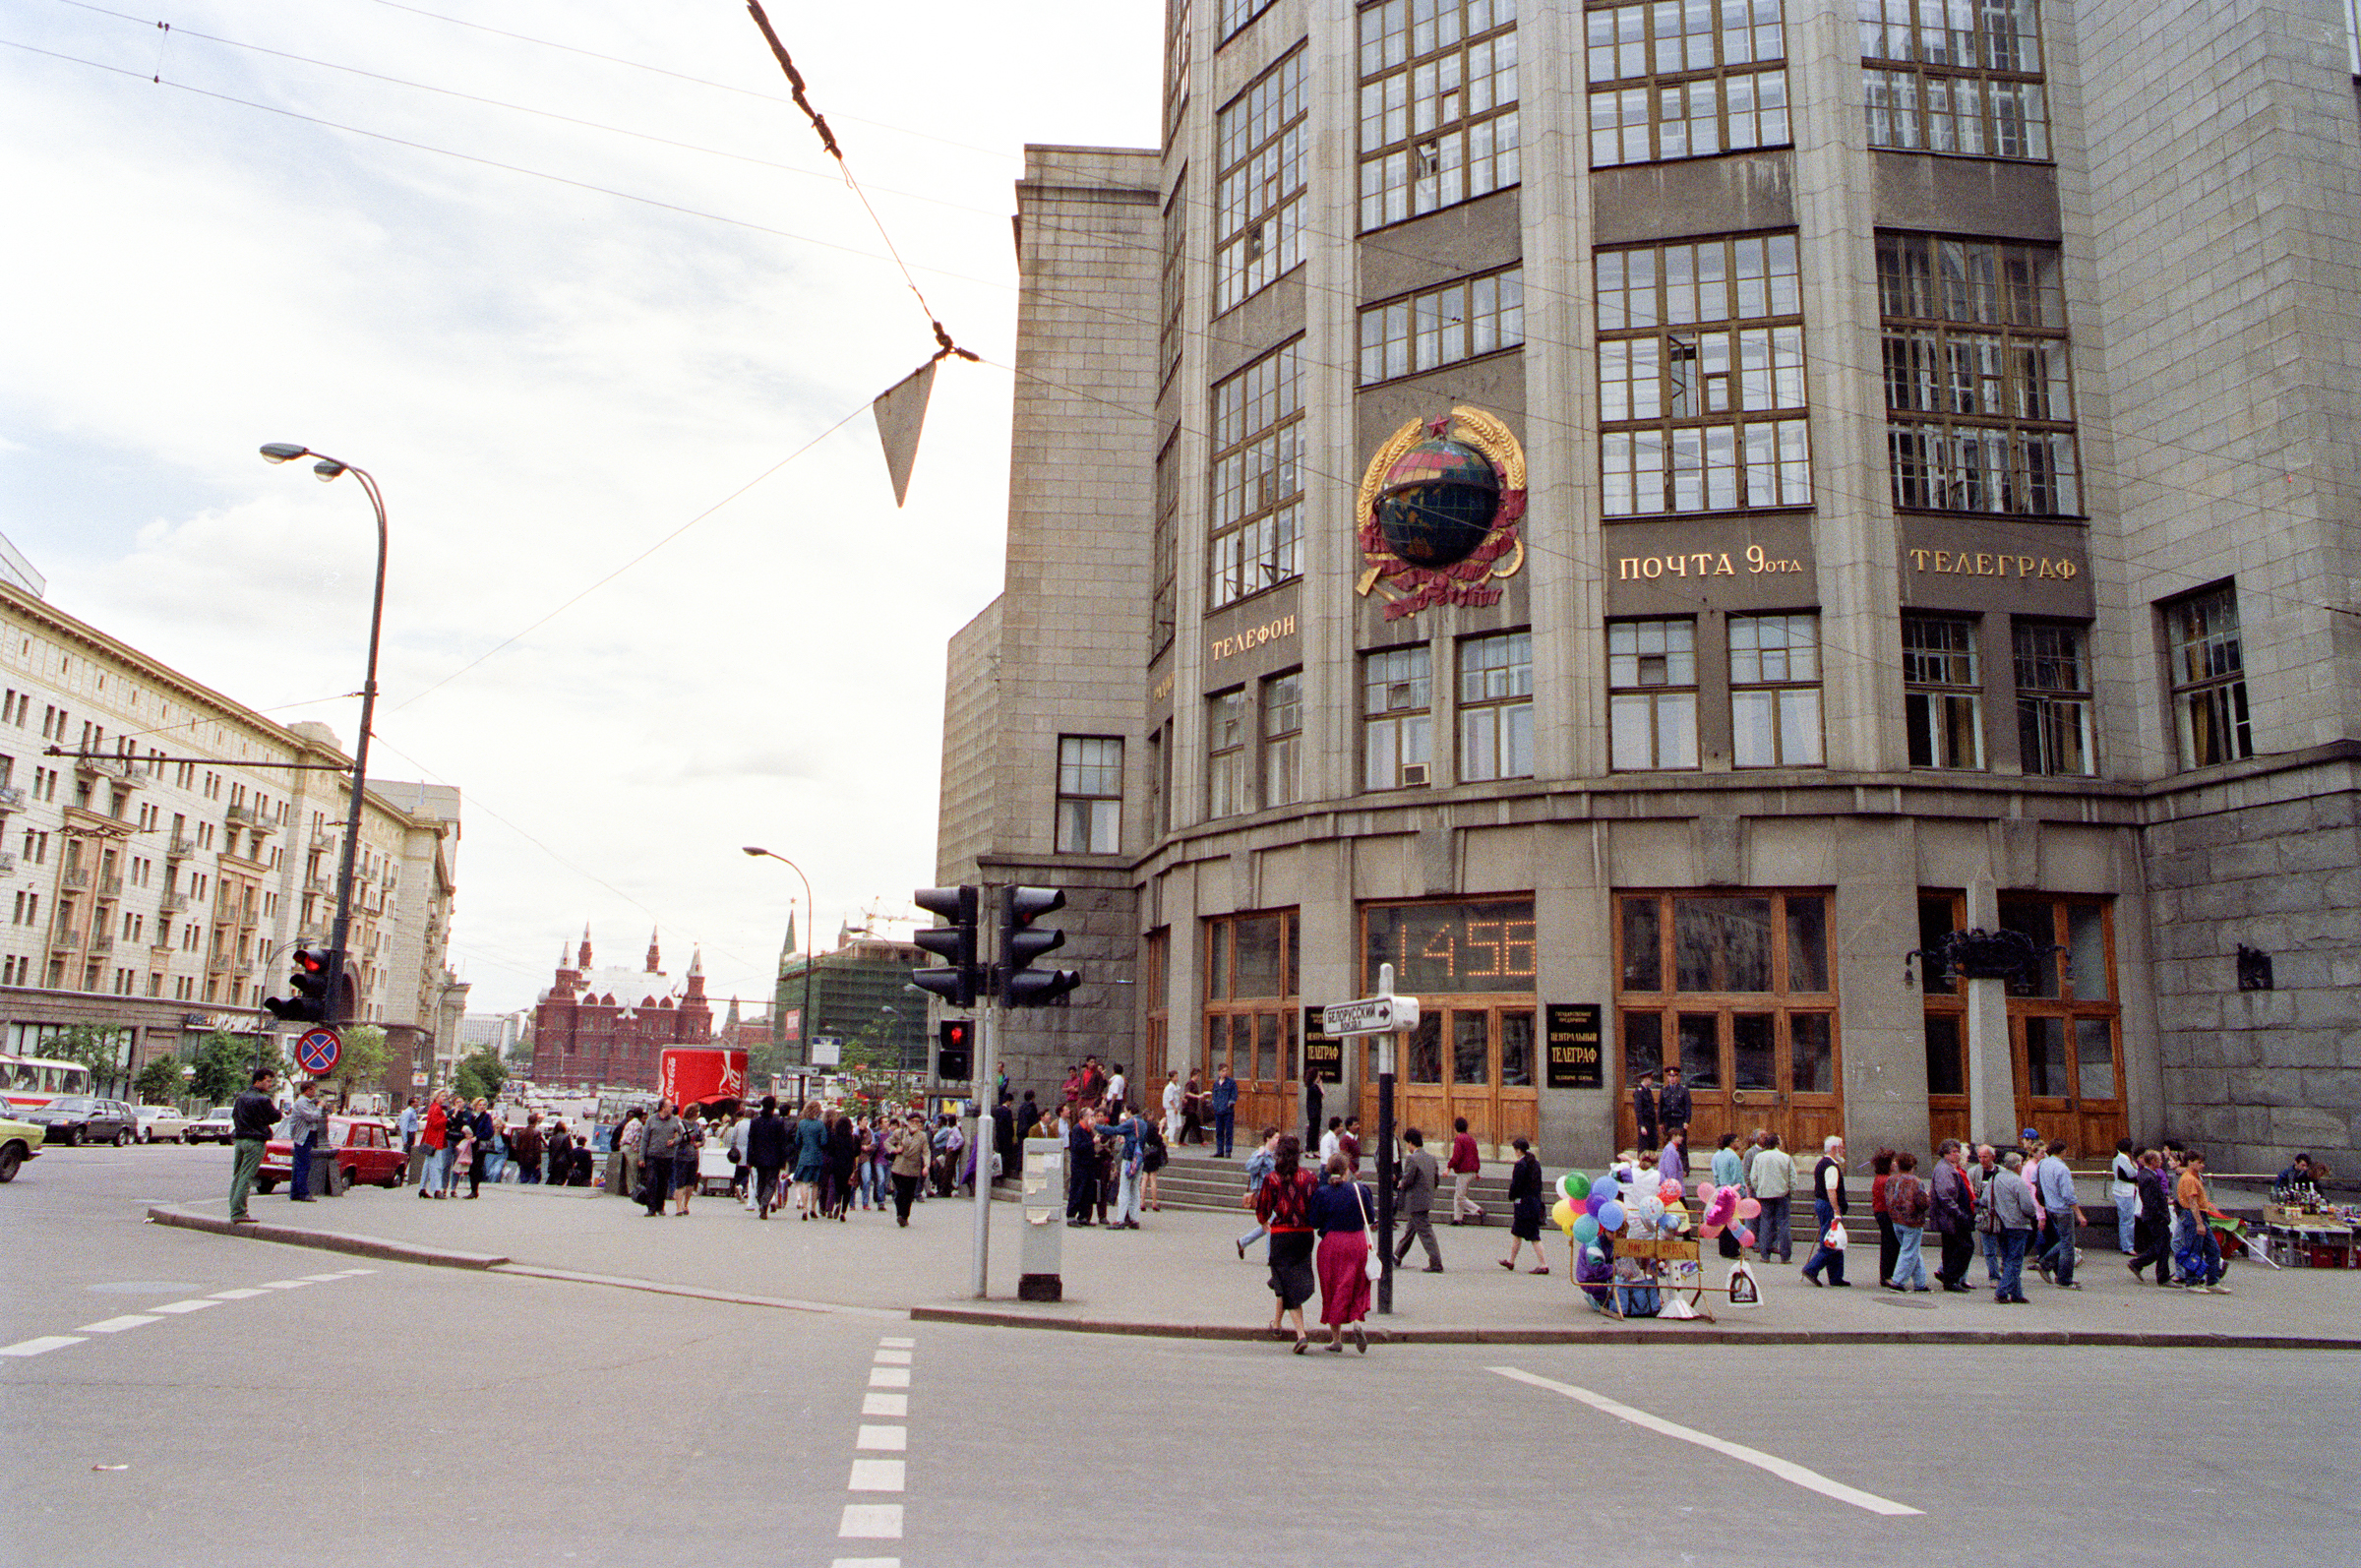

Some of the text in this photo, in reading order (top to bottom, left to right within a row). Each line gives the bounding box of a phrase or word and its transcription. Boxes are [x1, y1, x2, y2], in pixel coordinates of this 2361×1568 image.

[1619, 553, 1735, 580] ПОЧТА
[1909, 549, 2078, 580] ТЕЛЕГРАФ
[1211, 615, 1296, 661] ТЕЛЕФОН
[1327, 1003, 1376, 1024] БЕЛОРУССКИЙ
[1550, 1032, 1598, 1042] ЦЕНТРАЛЬНЫЙ
[1306, 1046, 1339, 1060] ТЕЛЕГРАФ
[1551, 1047, 1598, 1062] ТЕЛЕГРАФ
